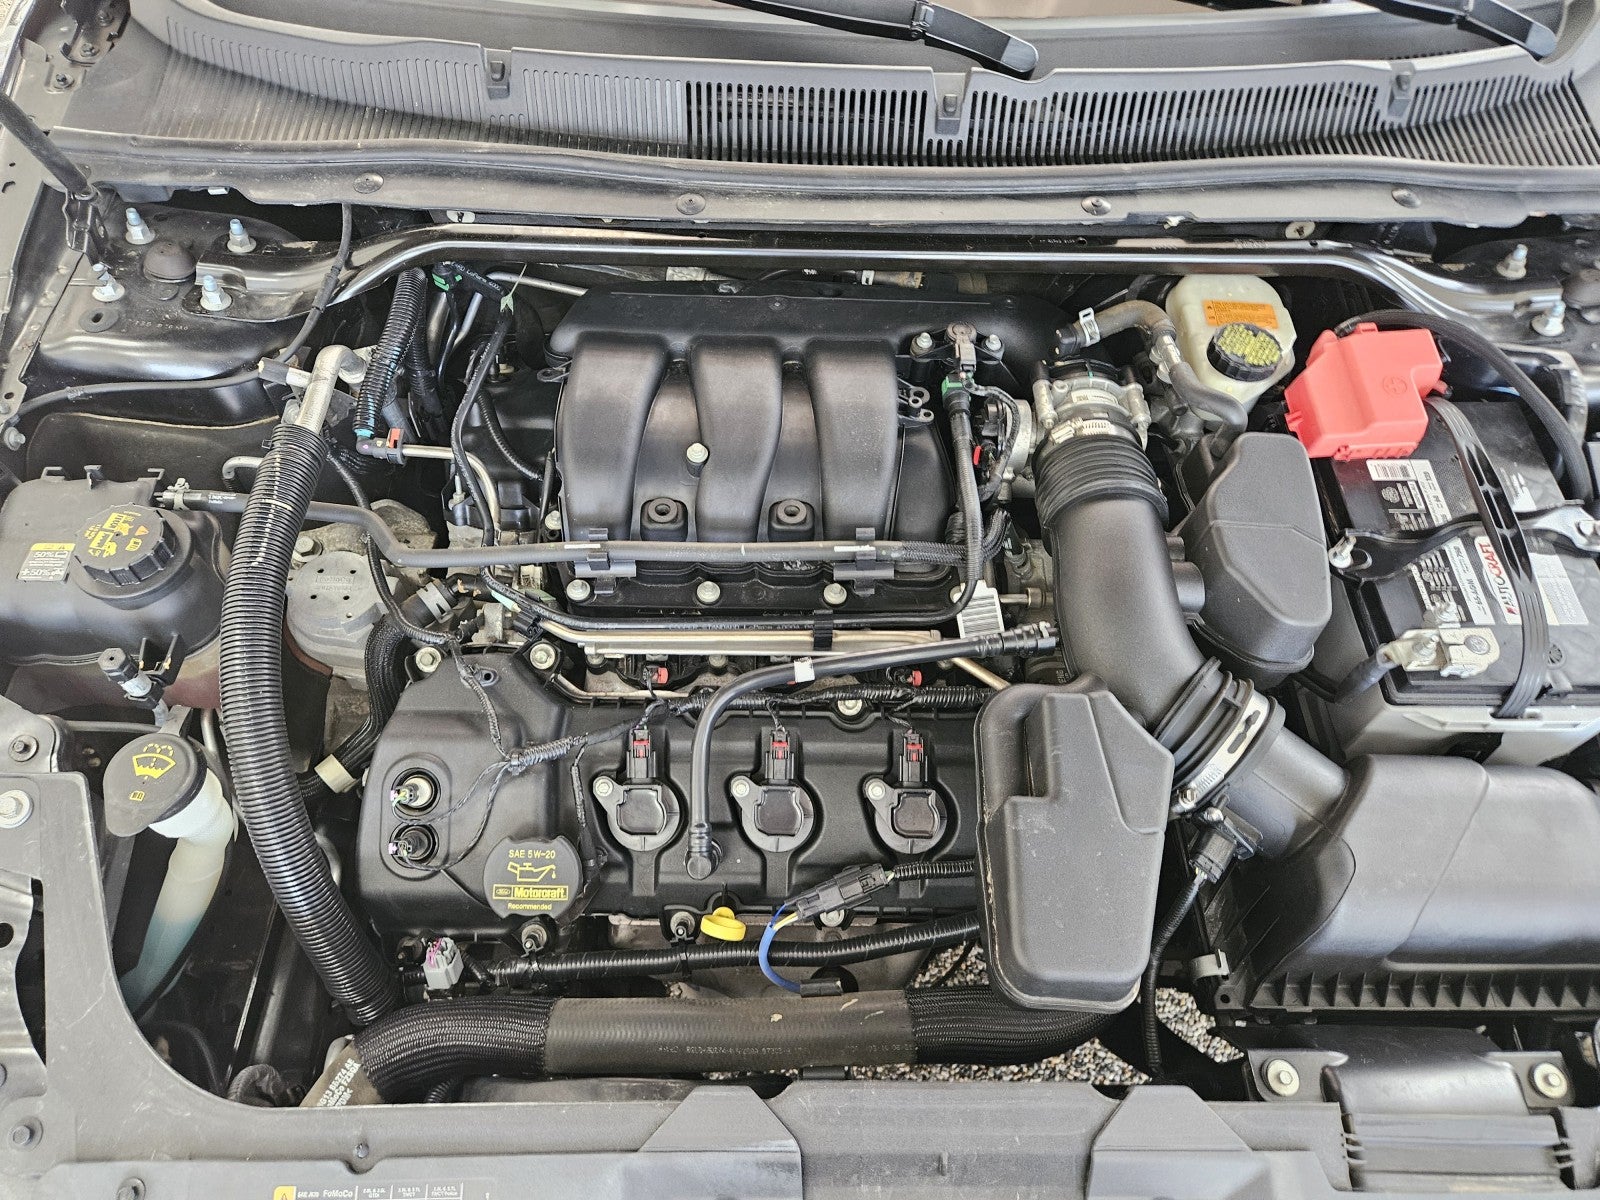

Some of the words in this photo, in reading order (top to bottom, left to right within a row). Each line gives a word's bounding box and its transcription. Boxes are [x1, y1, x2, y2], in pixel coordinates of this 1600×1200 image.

[508, 850, 526, 859] SAE
[514, 886, 566, 899] Motorcraft
[507, 902, 553, 911] Recommended
[323, 1189, 354, 1198] FoMoCo
